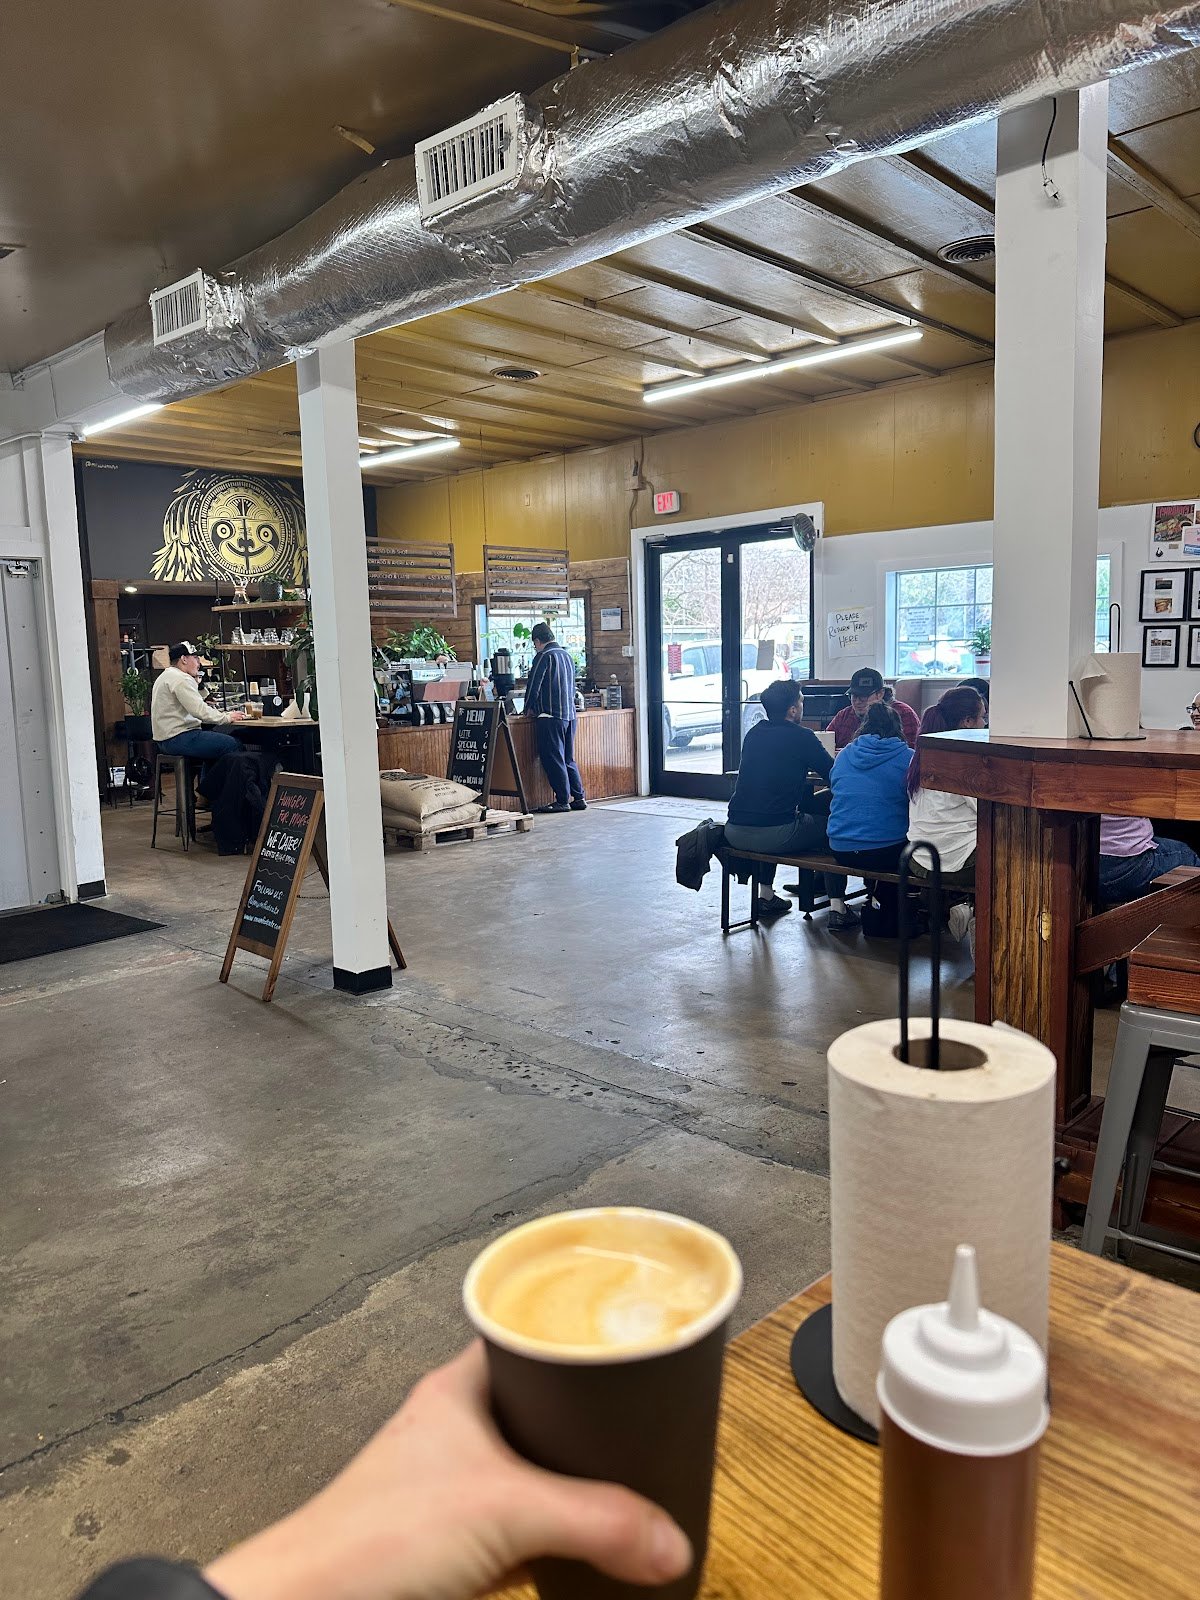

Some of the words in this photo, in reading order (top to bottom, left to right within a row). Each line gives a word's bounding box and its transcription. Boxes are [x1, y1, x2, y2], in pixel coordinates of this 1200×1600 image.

[656, 493, 673, 512] EXIT
[835, 612, 860, 624] PLEASE
[838, 634, 858, 648] HERE
[466, 709, 486, 722] MENU
[481, 753, 486, 763] 5
[278, 791, 307, 809] HUNGRY
[267, 829, 282, 848] WE
